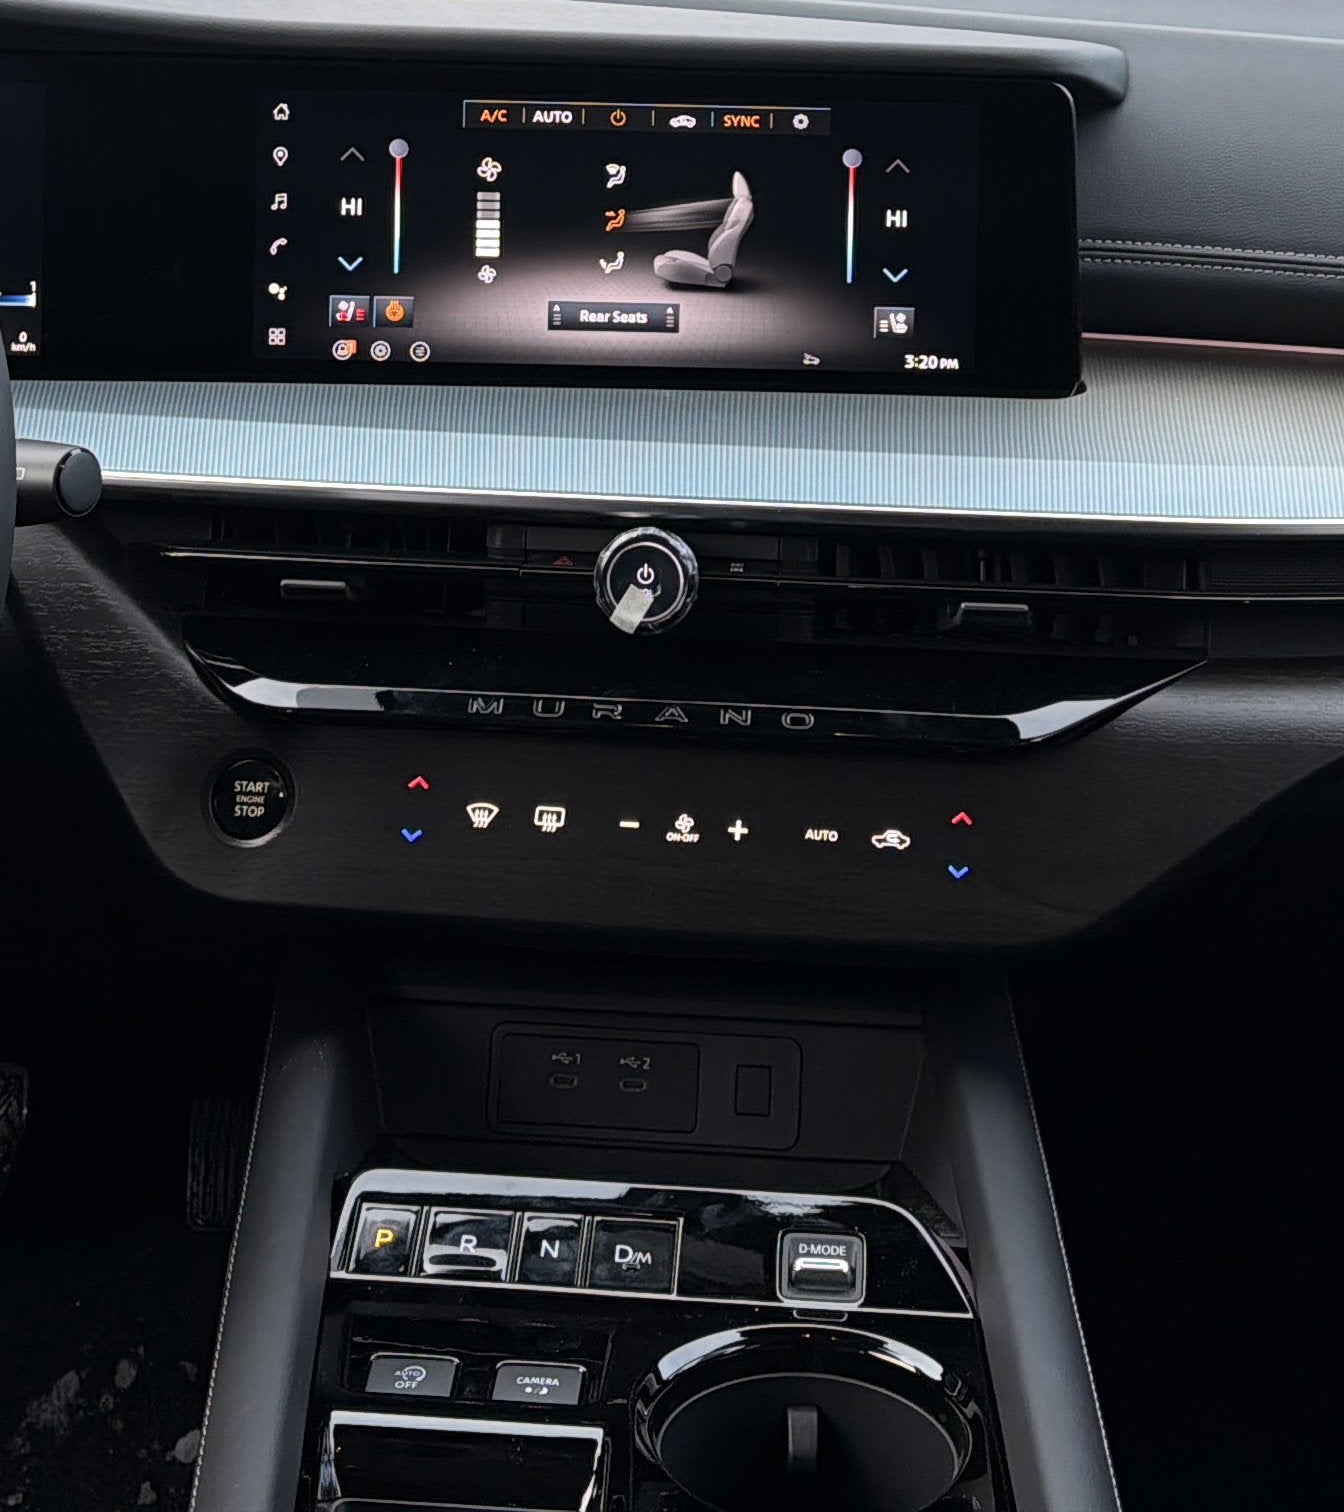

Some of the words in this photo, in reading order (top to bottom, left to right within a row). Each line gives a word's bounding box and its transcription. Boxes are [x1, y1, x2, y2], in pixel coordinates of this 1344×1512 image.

[479, 108, 508, 123] A/C
[532, 110, 573, 124] AUTO
[723, 114, 760, 129] SYNC
[340, 197, 363, 216] HI
[885, 209, 908, 228] HI
[580, 309, 609, 323] Rear
[612, 310, 648, 324] Seats
[19, 332, 27, 342] 0
[11, 342, 36, 352] km/h
[904, 354, 938, 370] 3:20
[940, 357, 959, 370] PM
[467, 696, 815, 729] MURANO
[234, 780, 271, 793] START
[236, 794, 266, 804] ENGINE
[234, 804, 265, 817] STOP
[805, 829, 838, 842] AUTO
[642, 1057, 651, 1070] 2
[374, 1228, 394, 1248] P
[459, 1234, 477, 1253] R
[541, 1240, 559, 1258] N
[798, 1243, 847, 1257] D-MODE
[394, 1381, 419, 1389] OFF
[516, 1376, 560, 1386] CAMERA
